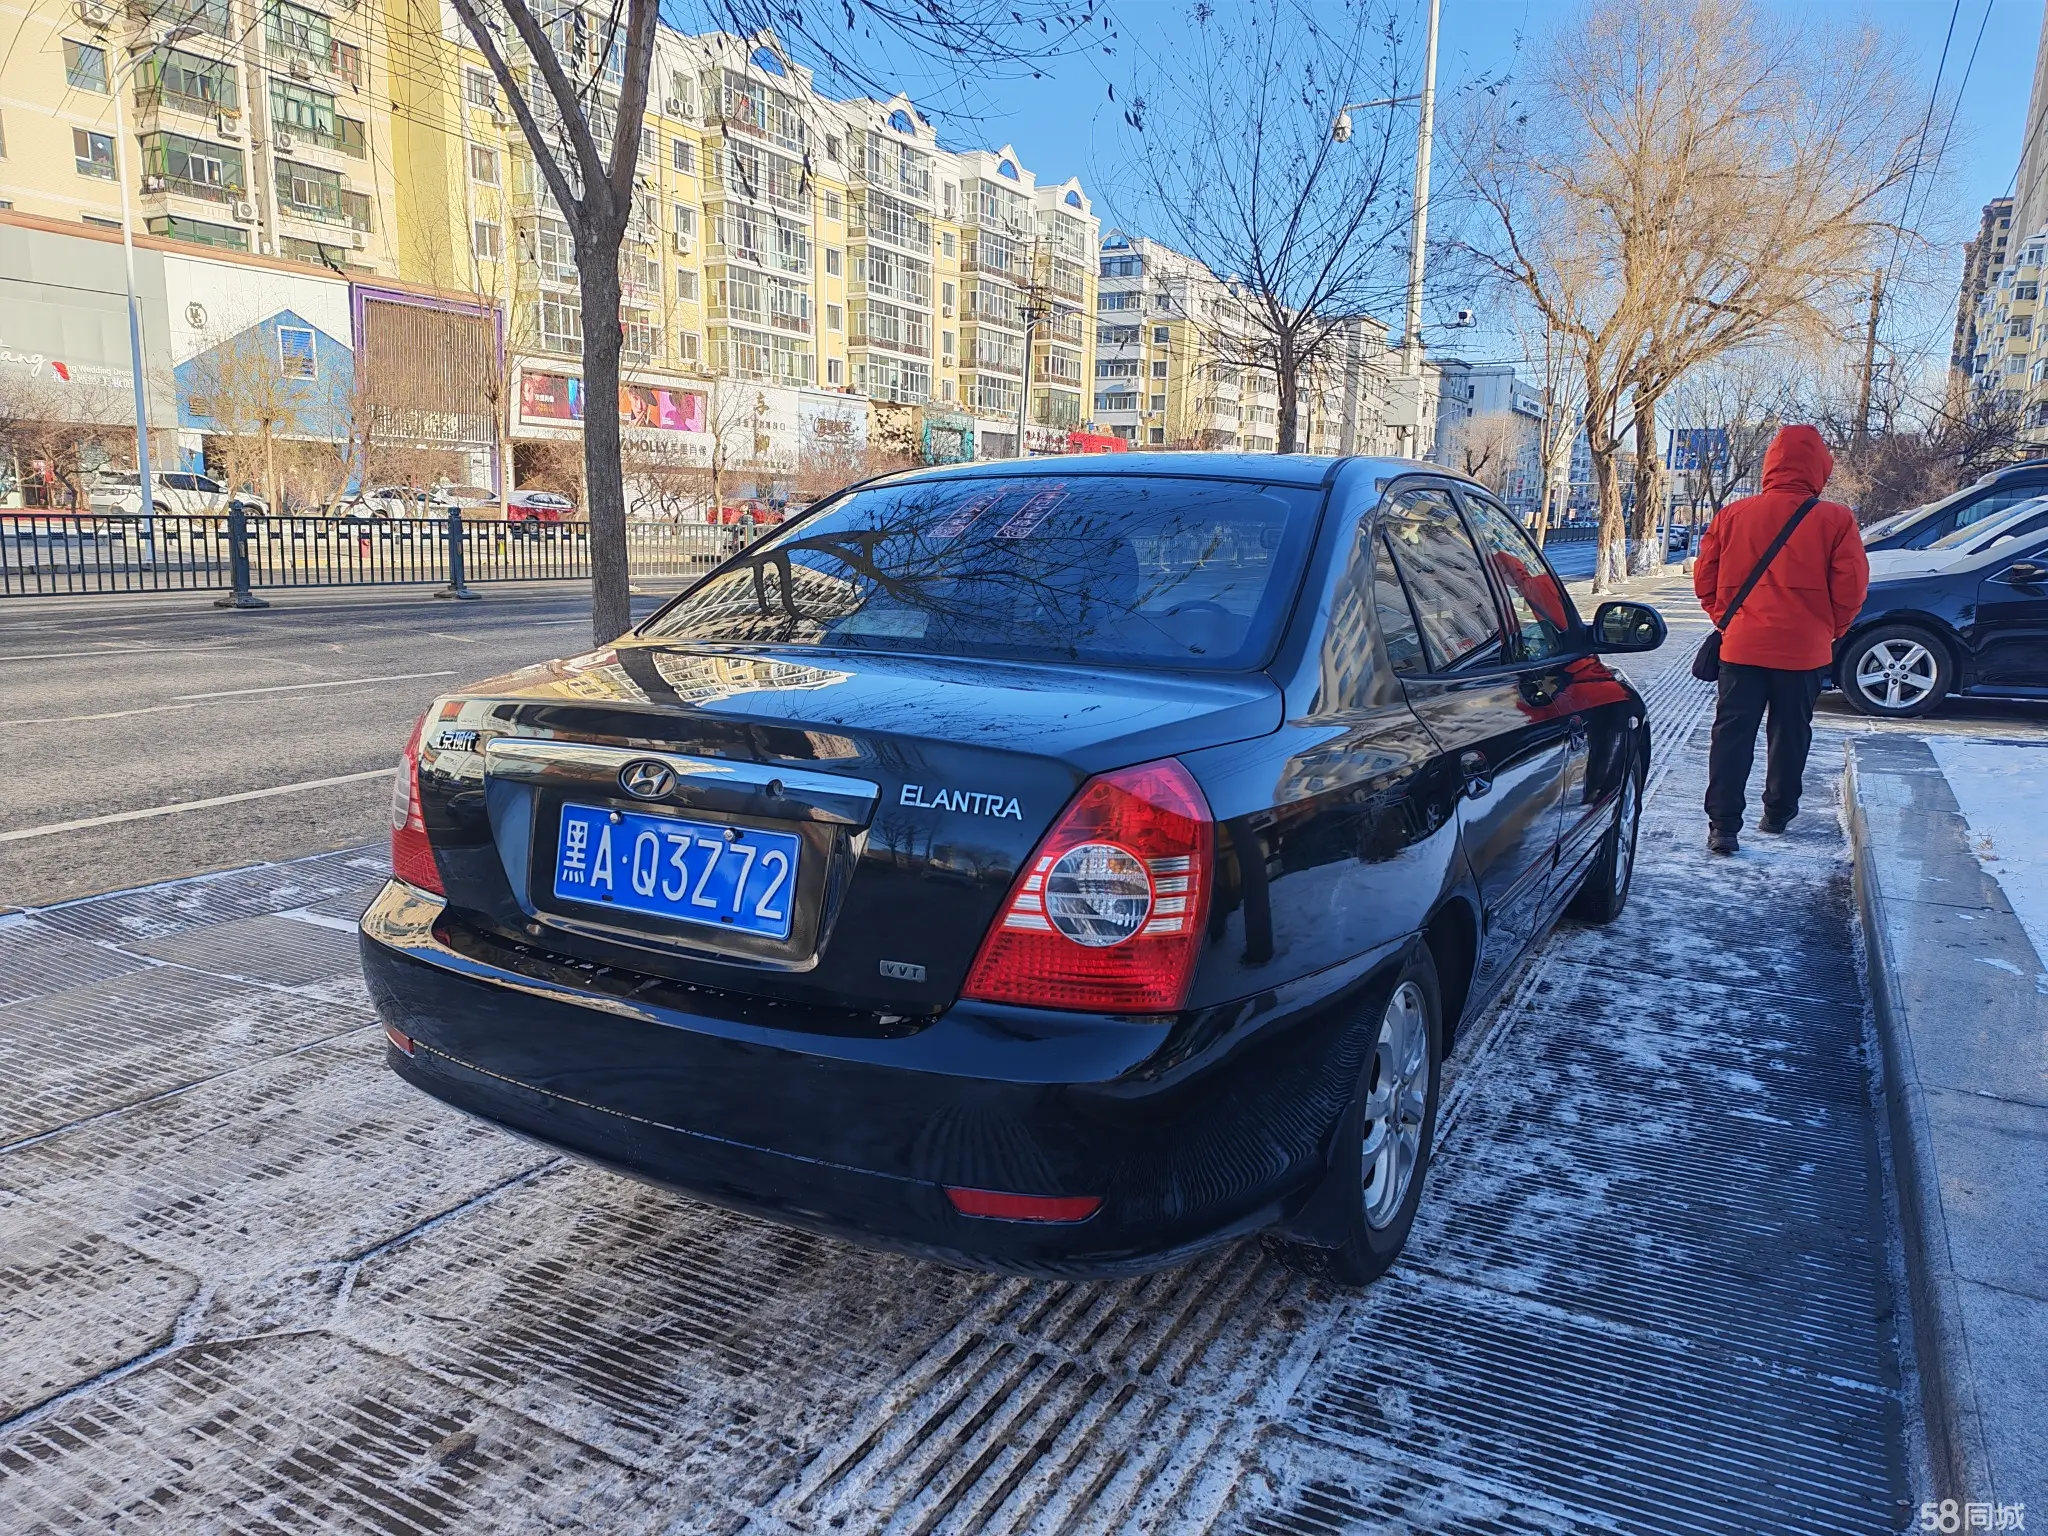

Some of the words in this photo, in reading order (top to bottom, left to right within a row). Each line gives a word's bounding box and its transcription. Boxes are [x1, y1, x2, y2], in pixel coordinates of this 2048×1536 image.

[79, 365, 112, 376] Wedding
[900, 784, 1023, 821] ELANTRA
[562, 819, 789, 920] 黑A·Q3Z72
[886, 963, 920, 980] VVT
